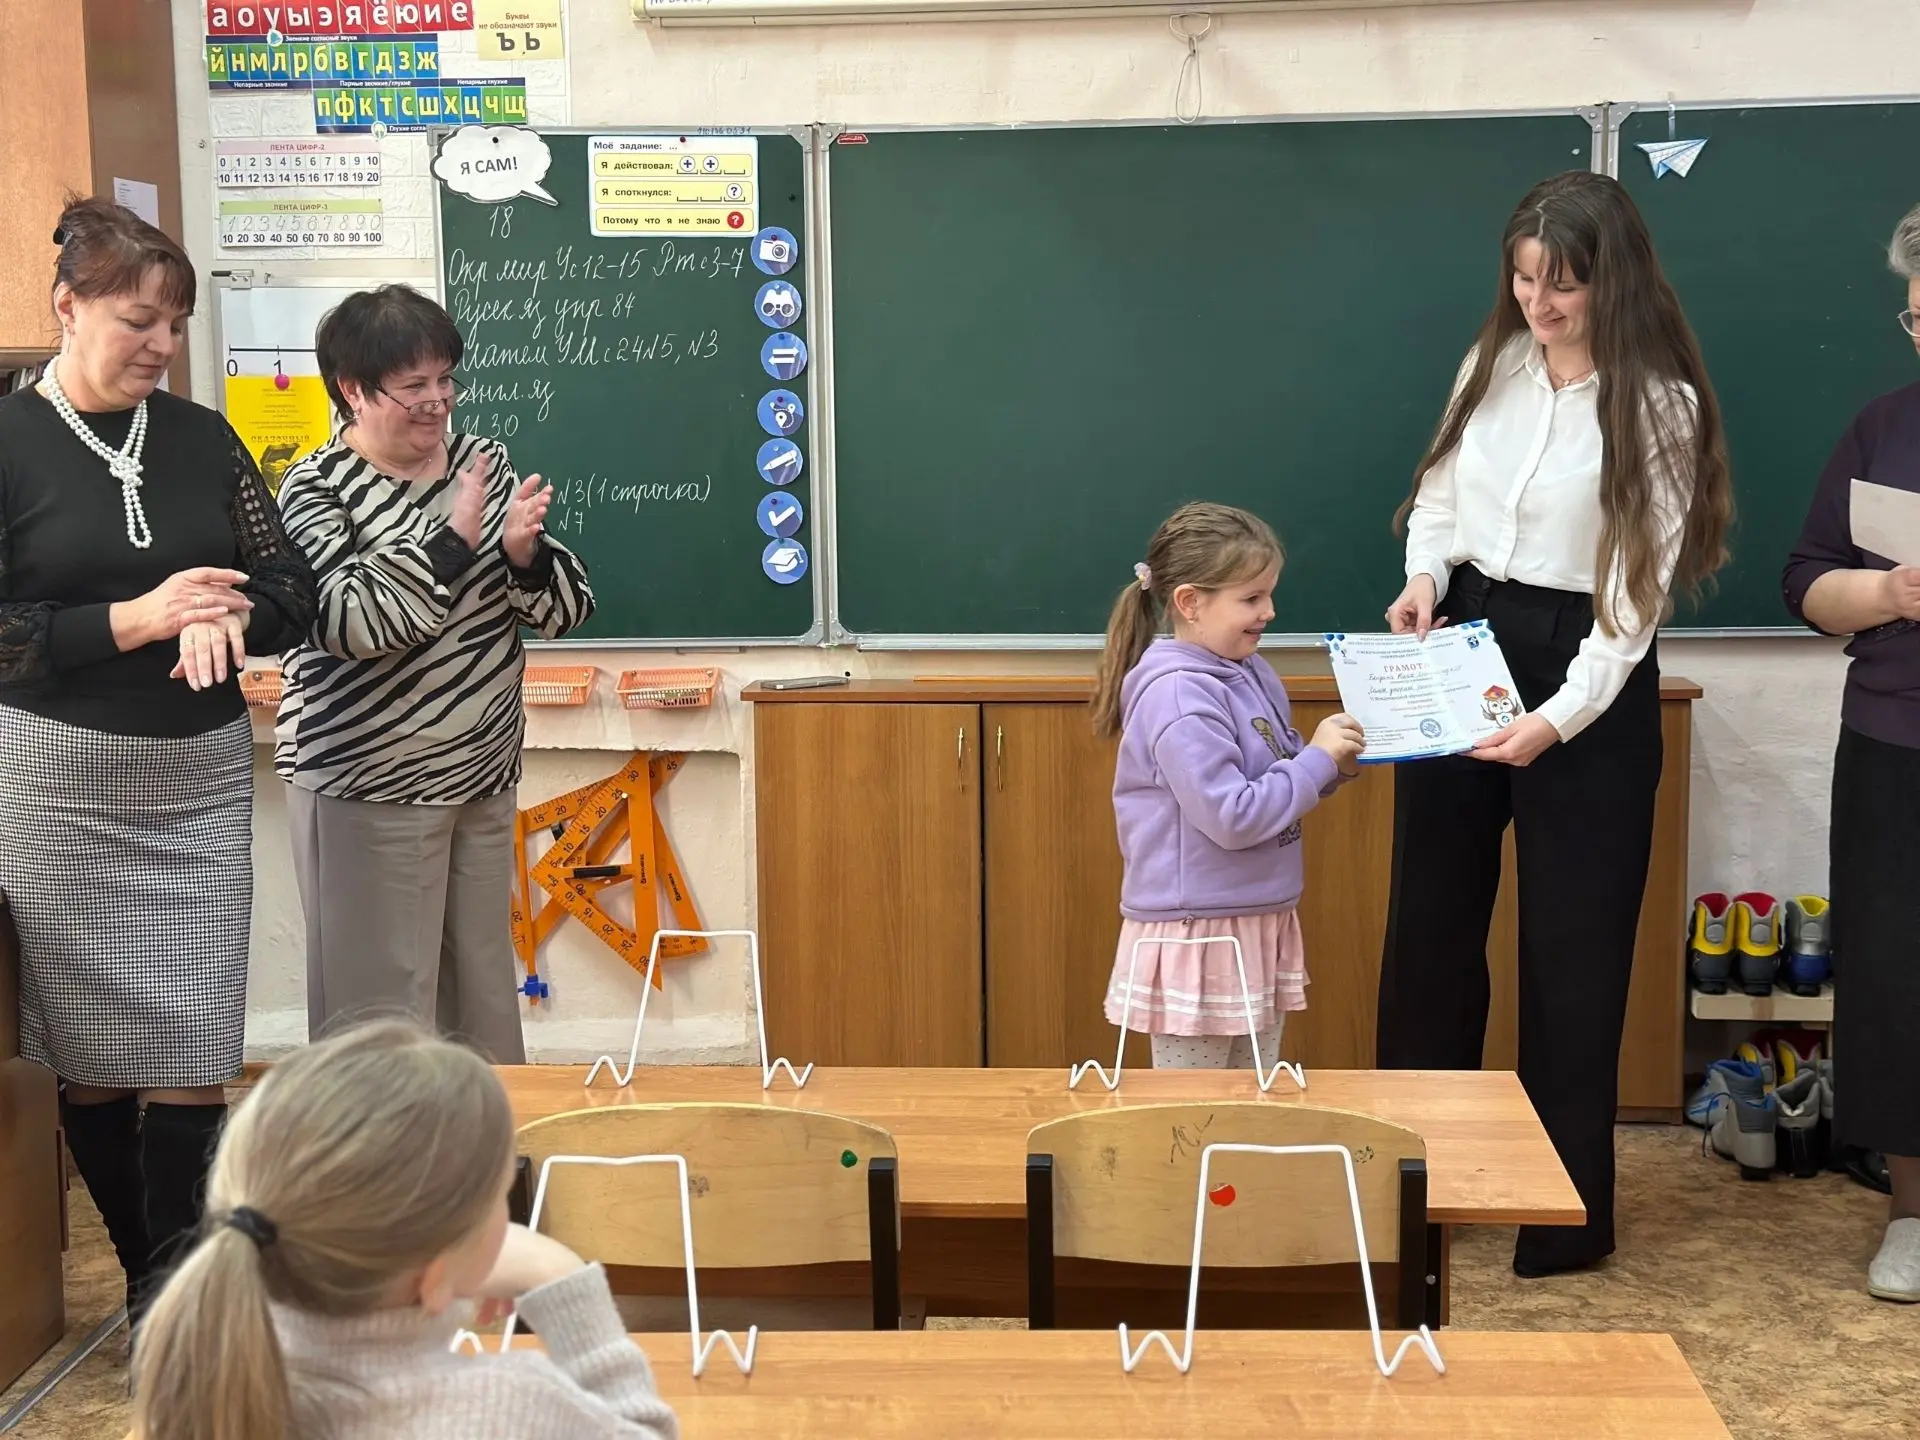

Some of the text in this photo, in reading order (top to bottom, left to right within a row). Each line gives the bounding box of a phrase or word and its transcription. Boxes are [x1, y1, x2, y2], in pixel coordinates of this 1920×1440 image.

[490, 22, 534, 30] обозначают
[536, 22, 557, 30] звуки
[594, 141, 662, 151] Моё задание:
[220, 156, 378, 167] 0 1 2 3 4 5 6 7 8 9 10
[460, 156, 518, 175] Я САМ!
[614, 161, 673, 170] действовал:
[220, 173, 379, 183] 10 11 12 13 14 15 16 17 18 19 20
[602, 188, 609, 196] Я
[615, 189, 671, 197] споткнулся:
[490, 206, 514, 238] 18
[603, 216, 638, 225] Потому
[223, 232, 381, 243] 10 20 30 40 50 60 70 80 90 100
[449, 248, 488, 300] Окр
[497, 260, 548, 298] мир
[612, 292, 636, 318] 84
[226, 359, 238, 376] 0
[490, 413, 519, 438] 30
[1384, 663, 1426, 673] ГРАМОТ
[555, 805, 567, 816] 20
[563, 842, 574, 853] 10
[580, 824, 590, 835] 15
[596, 807, 607, 818] 20
[628, 770, 639, 782] 30
